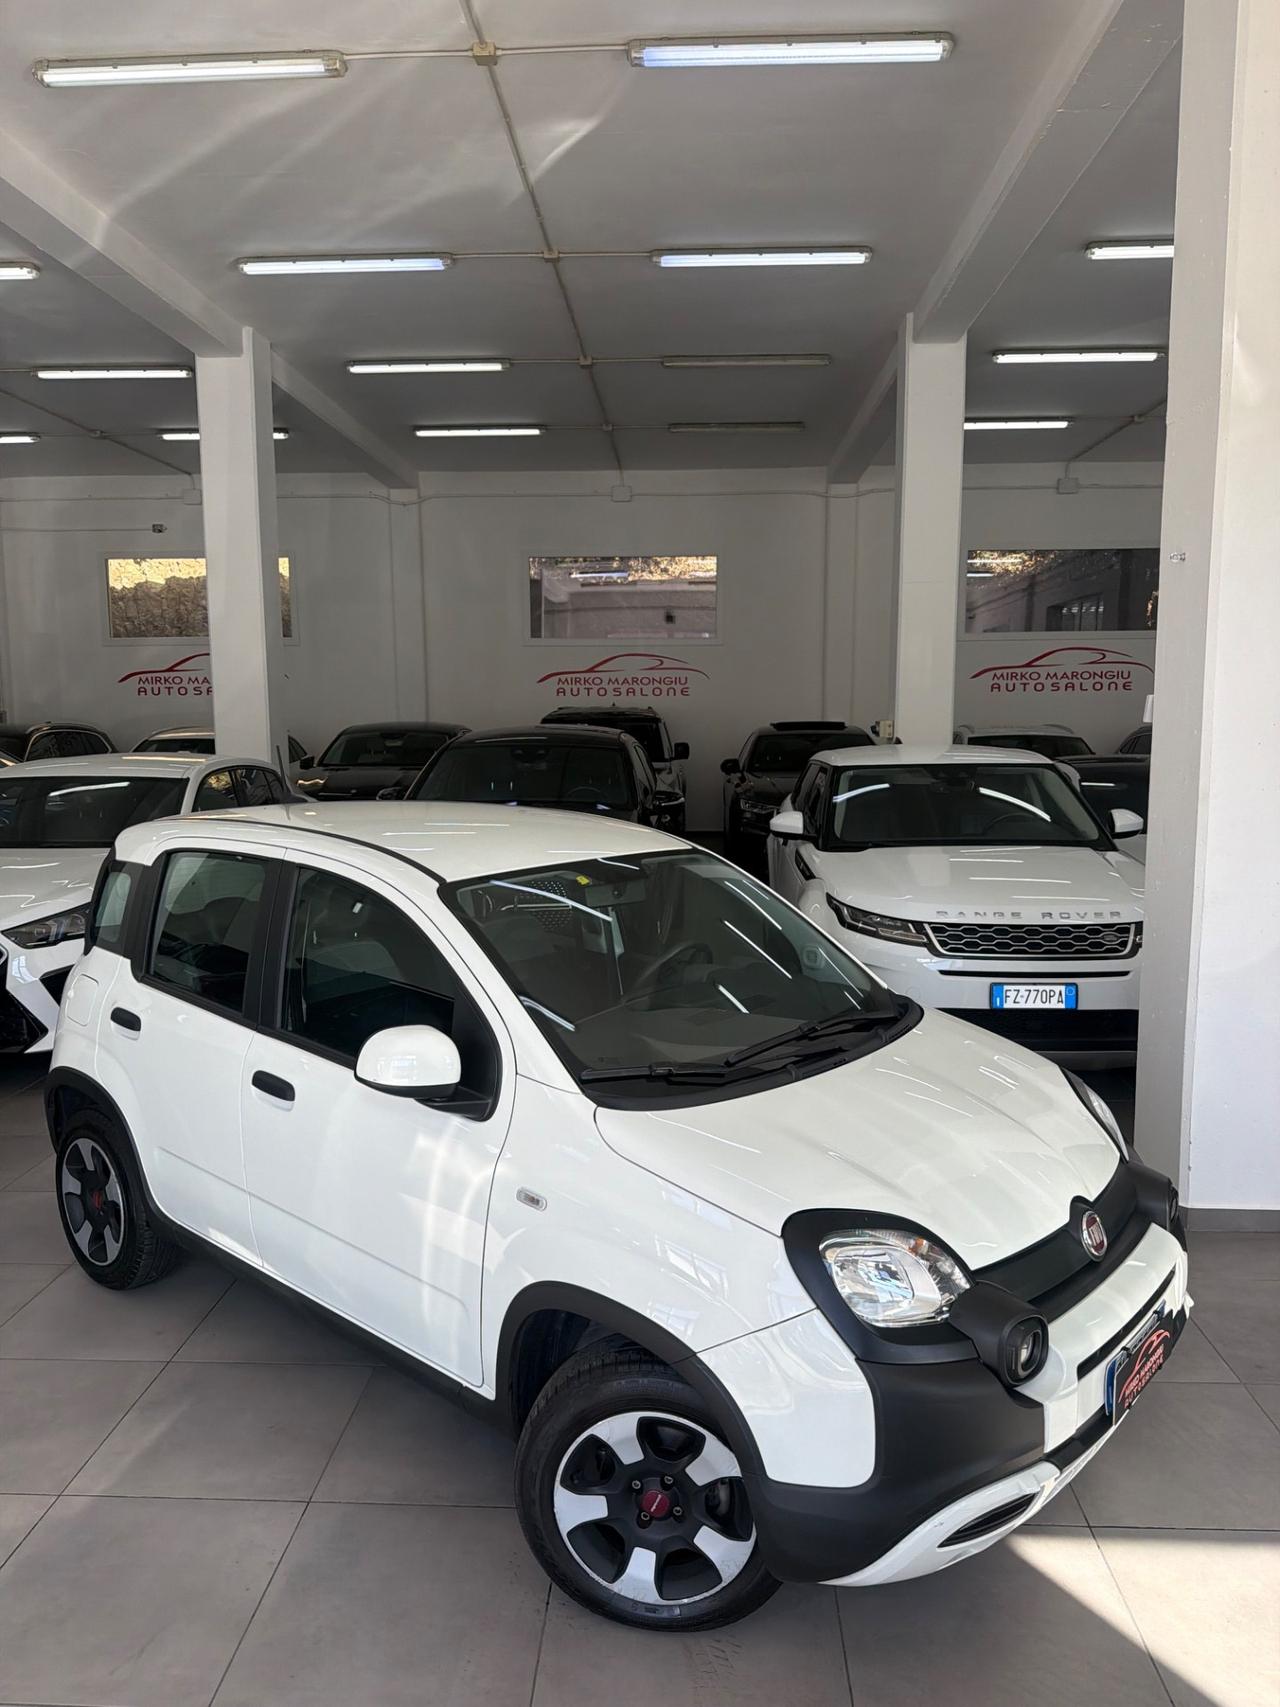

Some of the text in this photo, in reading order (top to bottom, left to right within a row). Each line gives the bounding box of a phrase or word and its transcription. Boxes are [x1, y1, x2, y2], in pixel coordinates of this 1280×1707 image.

[138, 676, 183, 685] MIRKO
[992, 670, 1131, 681] MIRKO MARONGIU
[557, 676, 688, 686] MIRKO MARONGIU
[556, 686, 690, 697] AUTOSALONE
[990, 681, 1133, 693] AUTOSALONE
[1041, 911, 1121, 920] ROVER
